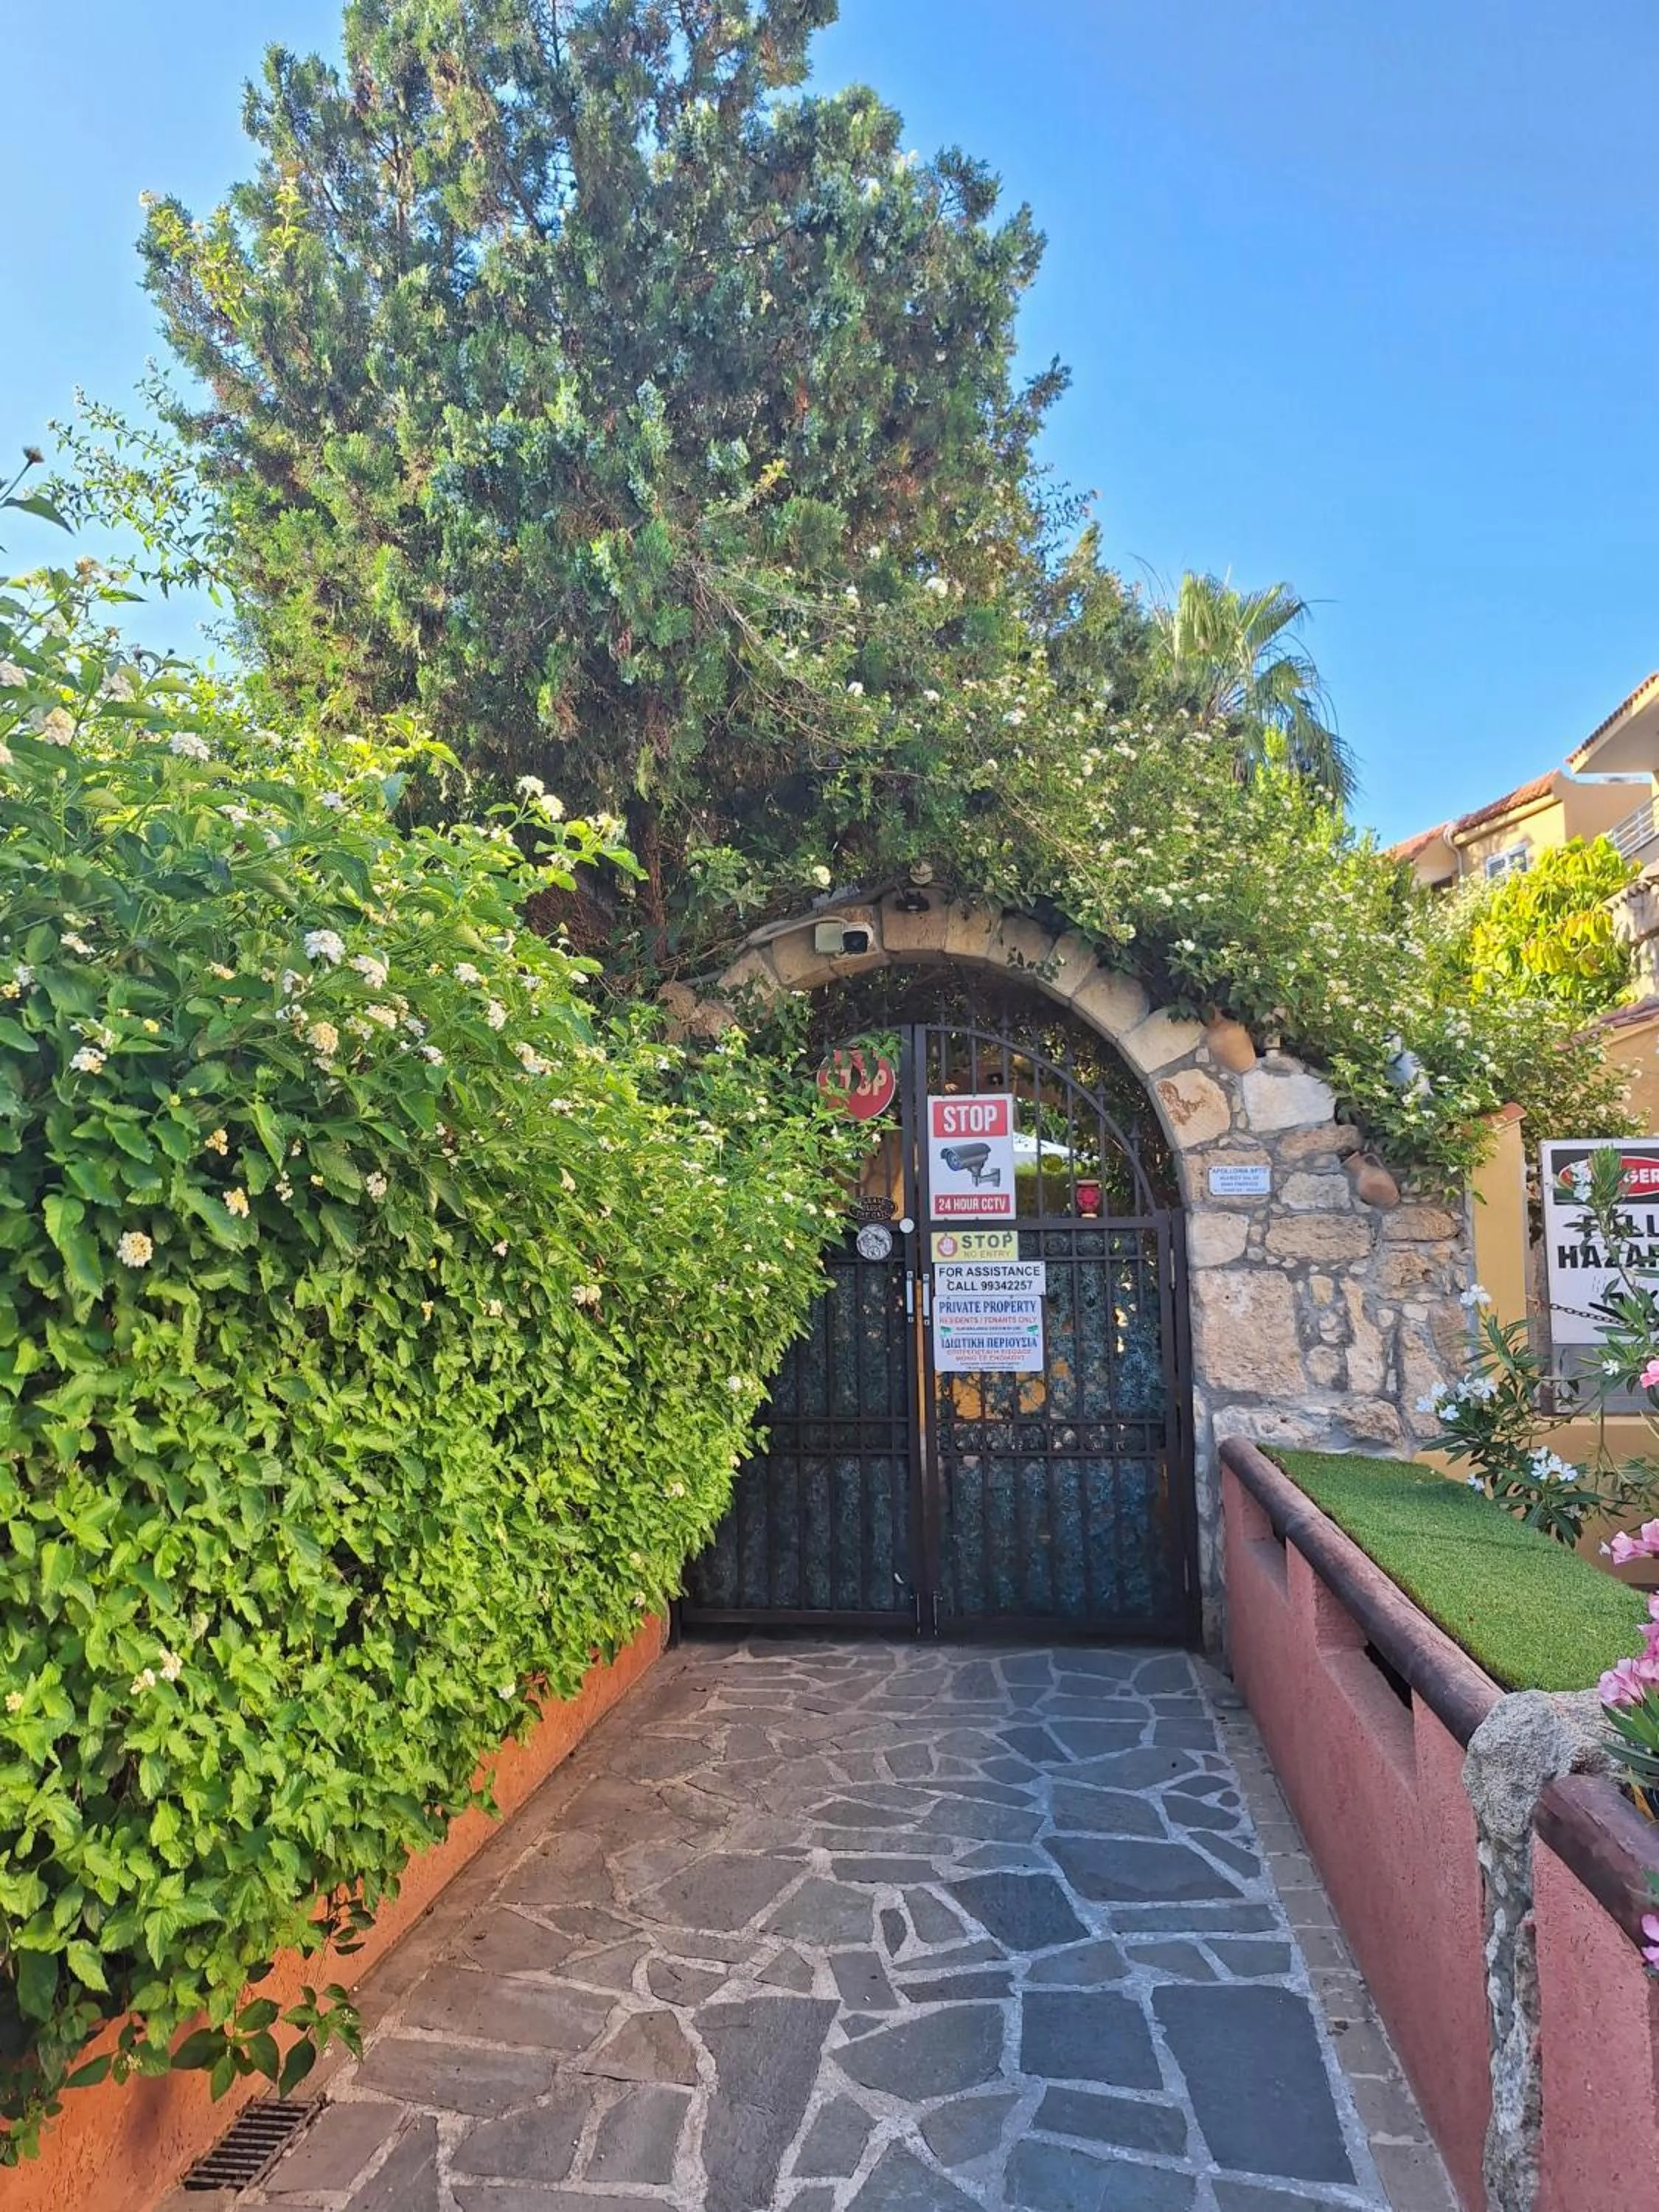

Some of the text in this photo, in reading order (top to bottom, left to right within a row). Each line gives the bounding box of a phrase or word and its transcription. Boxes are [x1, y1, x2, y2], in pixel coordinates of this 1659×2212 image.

[943, 1105, 997, 1133] STOP
[939, 1197, 1006, 1211] 24 HOUR CCTV
[1583, 1214, 1659, 1237] FLL
[962, 1234, 1012, 1248] STOP
[939, 1266, 1040, 1276] FOR ASSISTANCE
[947, 1279, 1032, 1290] CALL 99342257
[939, 1300, 1037, 1312] PRIVATE PROPERTY
